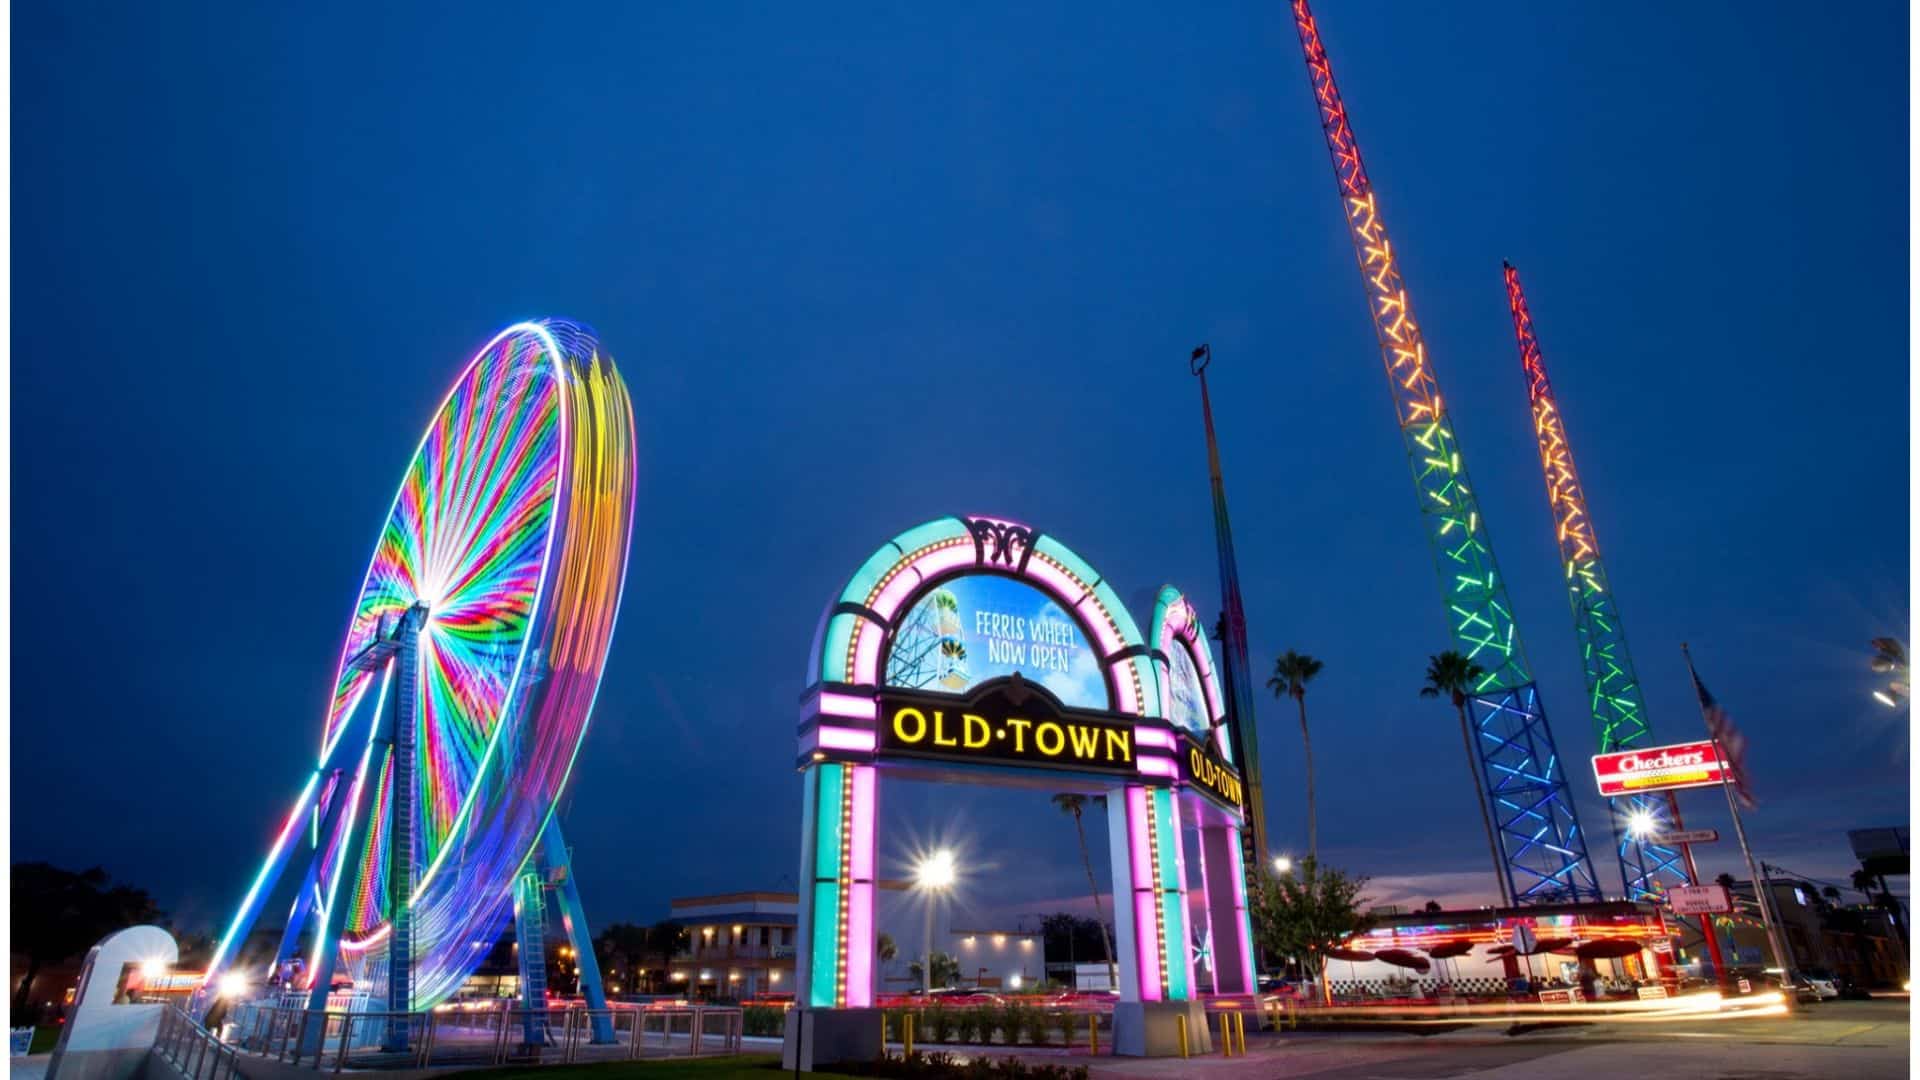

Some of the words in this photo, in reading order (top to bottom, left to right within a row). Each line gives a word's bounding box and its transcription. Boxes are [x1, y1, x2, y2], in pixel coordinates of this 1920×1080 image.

[976, 610, 1025, 641] FERRIS
[1029, 618, 1078, 649] WHEEL
[988, 637, 1027, 666] NOW
[1031, 643, 1069, 673] OPEN
[1618, 750, 1704, 773] Checkers
